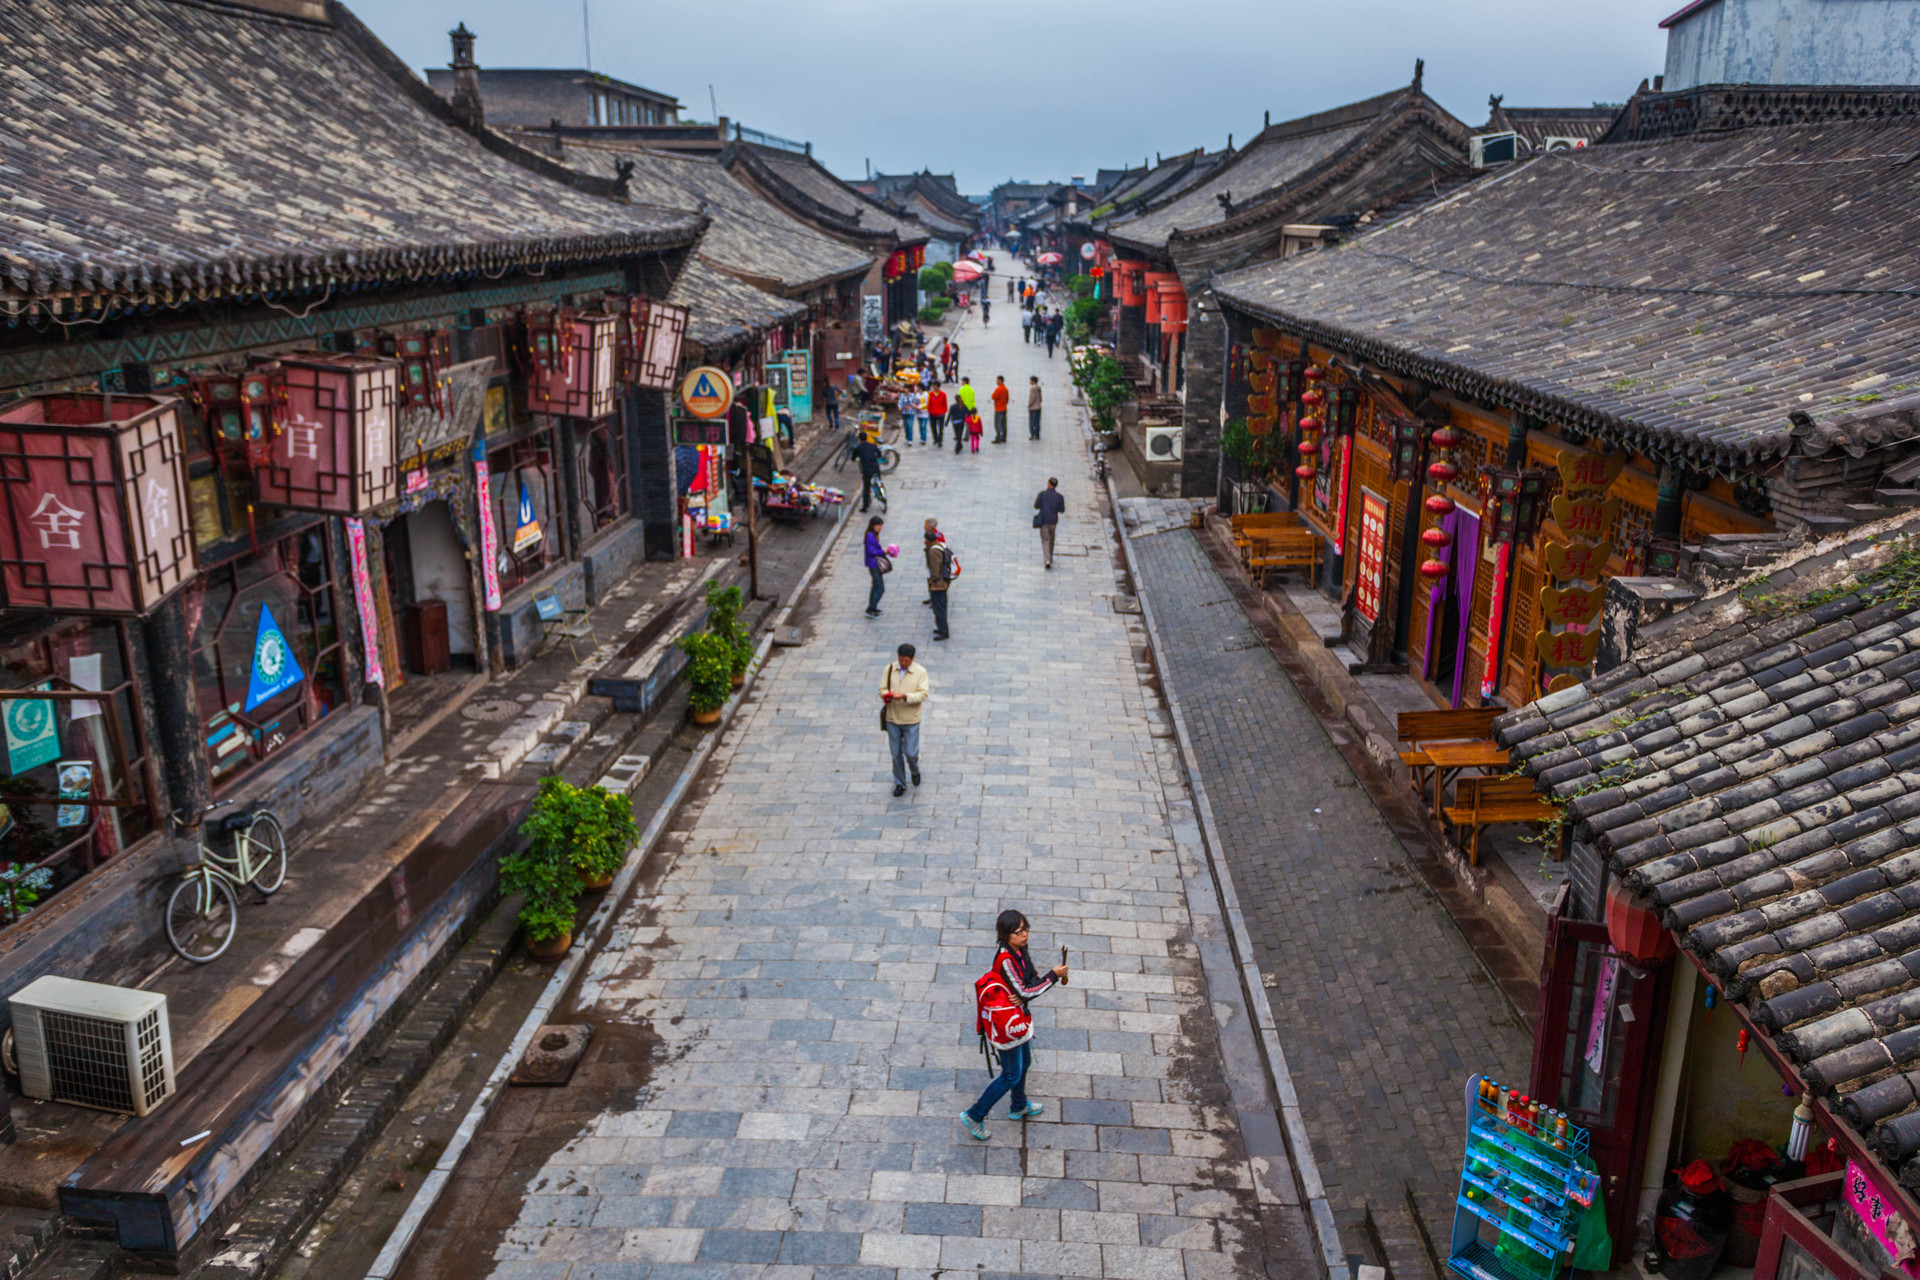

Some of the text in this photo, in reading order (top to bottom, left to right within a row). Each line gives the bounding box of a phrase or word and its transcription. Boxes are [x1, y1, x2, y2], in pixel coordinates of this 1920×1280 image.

[281, 413, 324, 461] 官
[365, 414, 386, 462] 官
[29, 492, 86, 550] 舍
[143, 477, 170, 539] 舍
[520, 499, 531, 524] U
[1852, 1176, 1890, 1227] 好事
